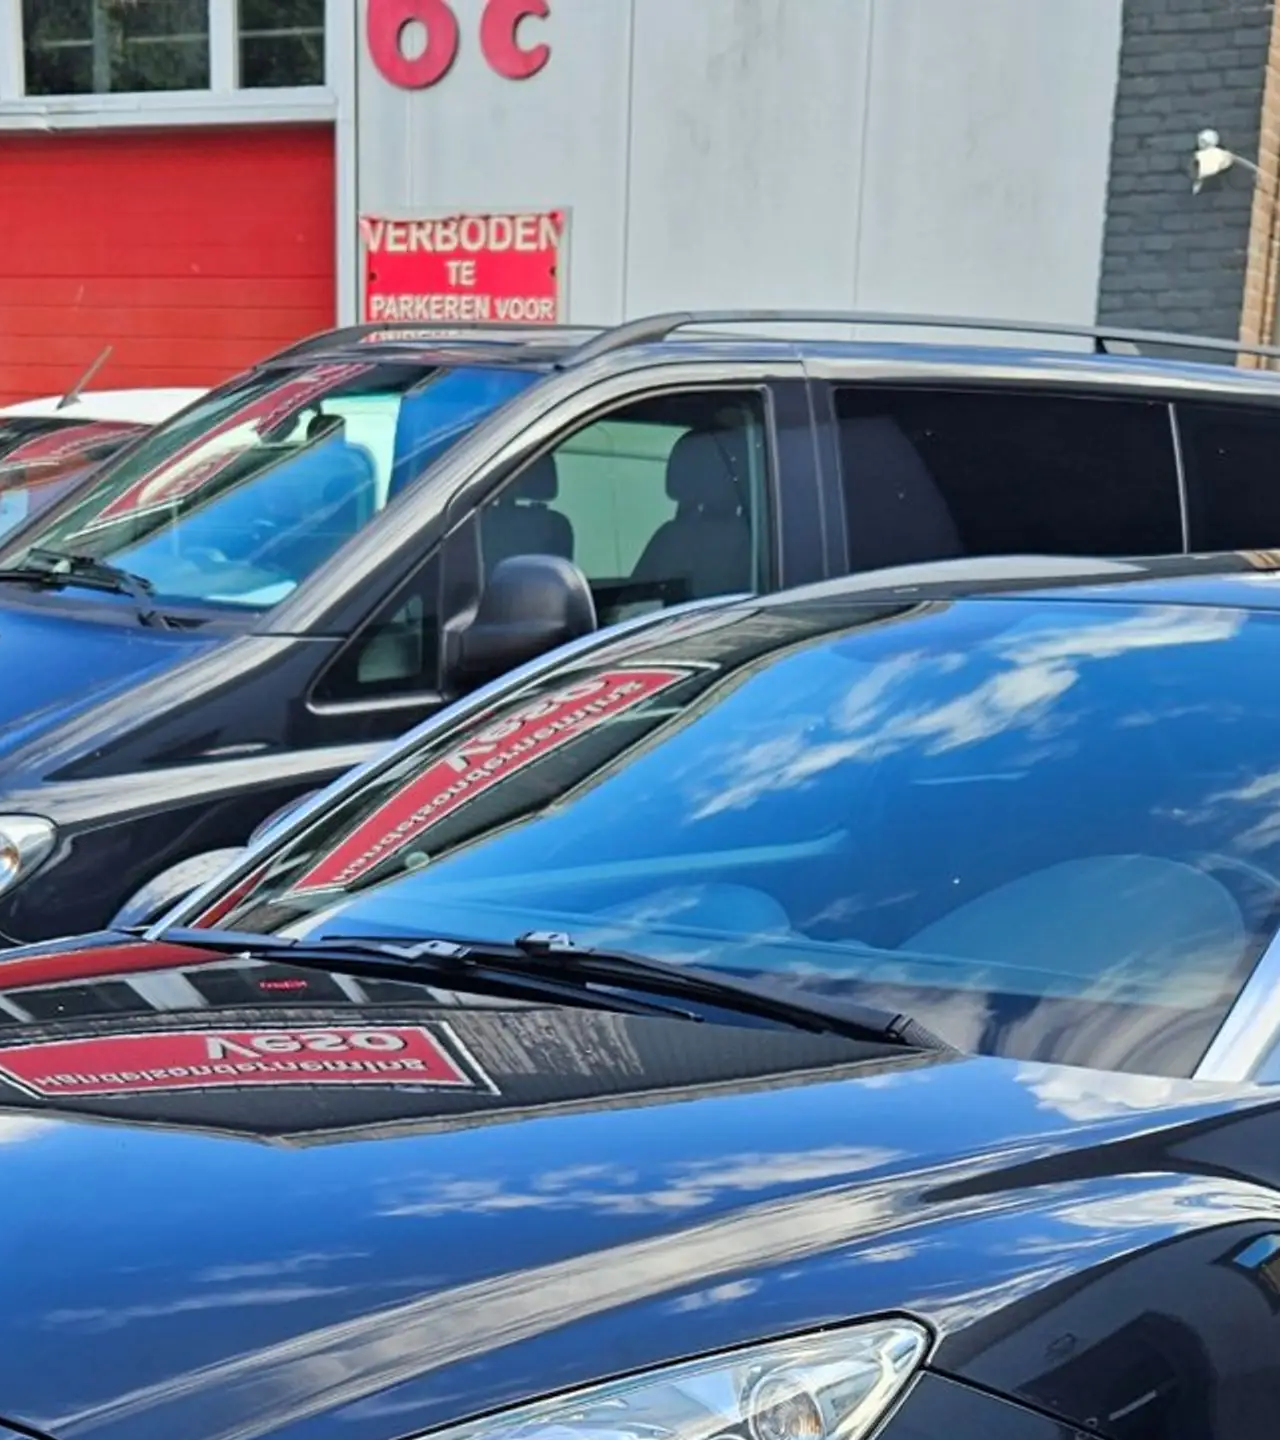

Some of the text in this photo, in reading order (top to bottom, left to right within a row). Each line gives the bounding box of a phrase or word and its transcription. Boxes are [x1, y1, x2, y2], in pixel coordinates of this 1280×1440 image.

[362, 215, 563, 253] VERBODEN
[446, 259, 477, 286] TE
[369, 294, 555, 321] PARKEREN VOOR
